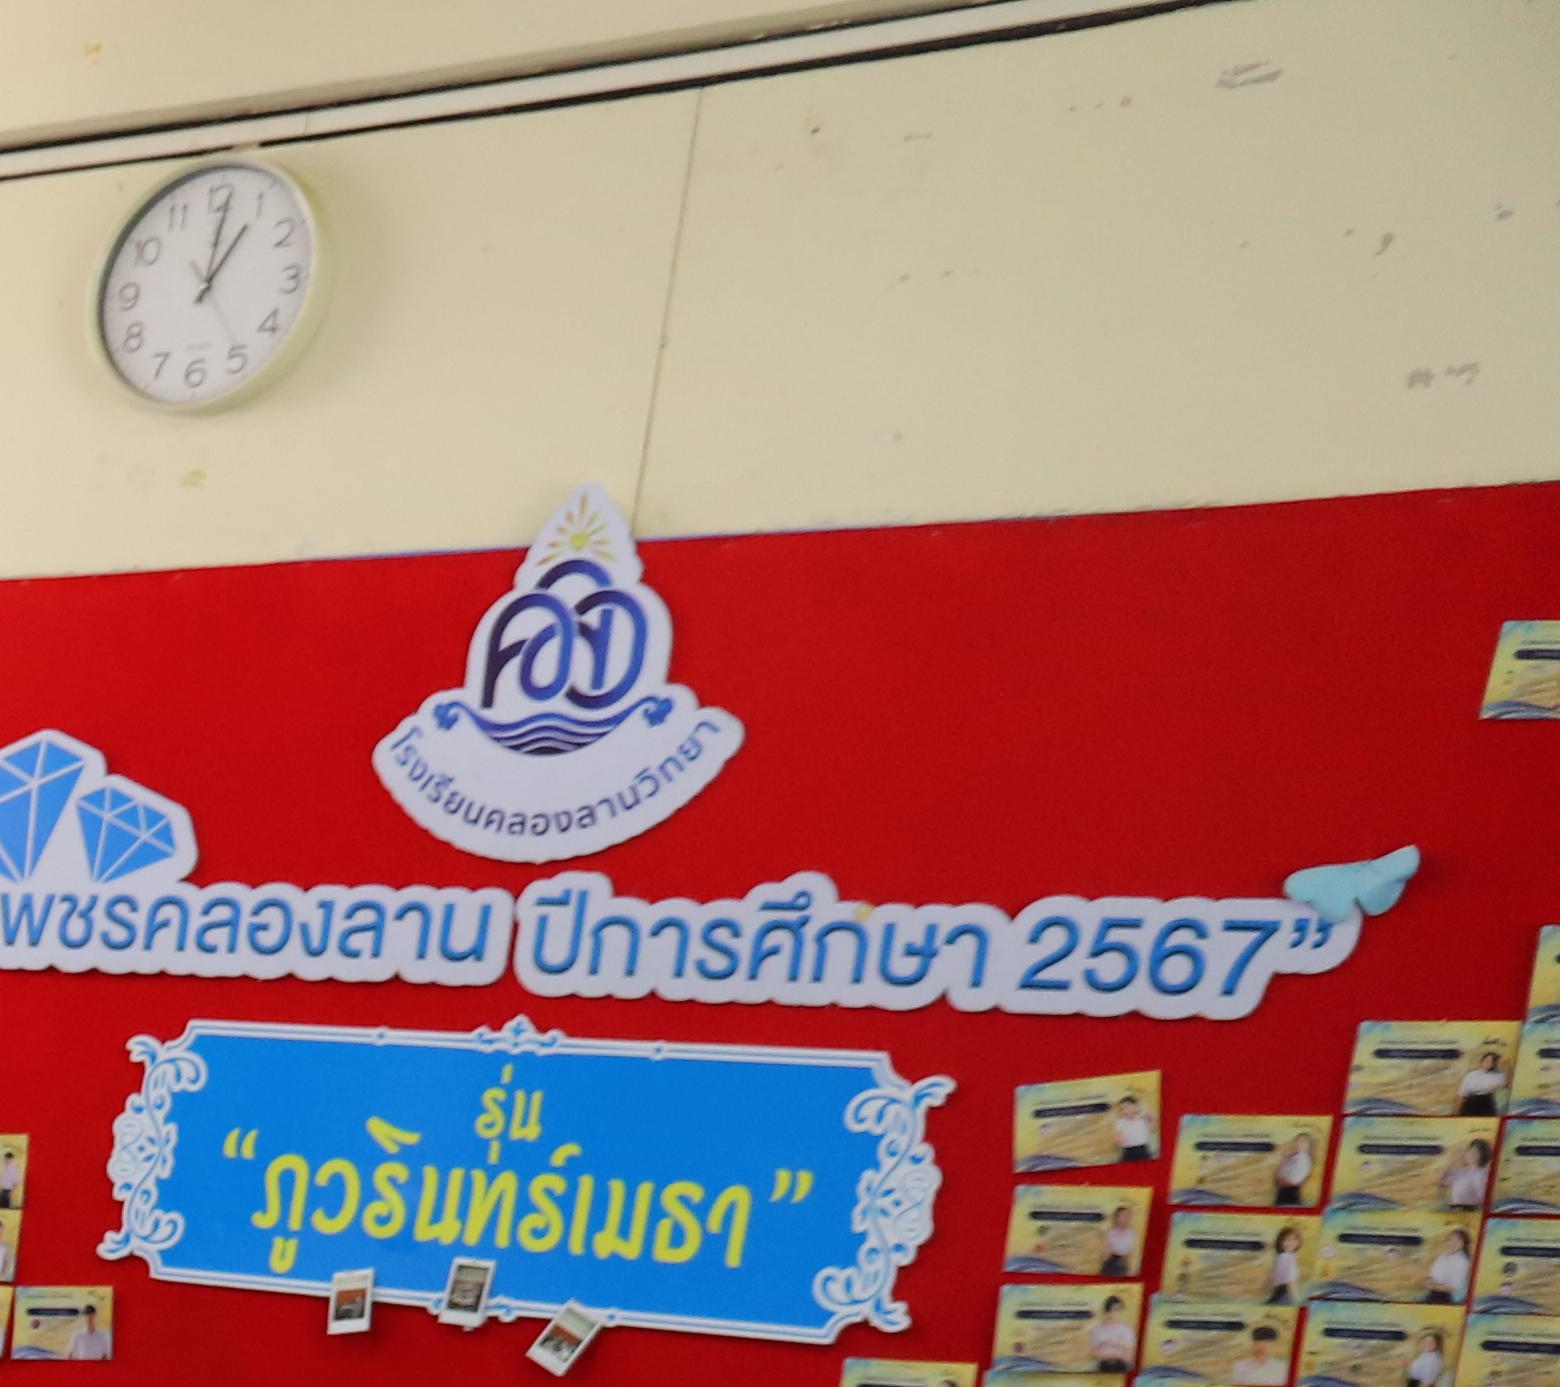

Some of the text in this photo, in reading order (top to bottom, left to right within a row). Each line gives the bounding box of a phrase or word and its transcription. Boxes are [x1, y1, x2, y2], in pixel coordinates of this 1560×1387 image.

[168, 204, 188, 230] 11
[274, 218, 294, 249] 2
[134, 235, 161, 267] 10
[280, 265, 300, 294] 3
[119, 282, 140, 311] 9
[124, 322, 144, 353] 8
[257, 308, 278, 337] 4
[152, 352, 171, 381] 7
[184, 359, 206, 388] 6
[227, 344, 248, 374] 5
[389, 719, 721, 837] โรงเรียนคลองลานวิทยา
[532, 886, 991, 988] ปีการศึกษา
[473, 1061, 545, 1166] รุ่น
